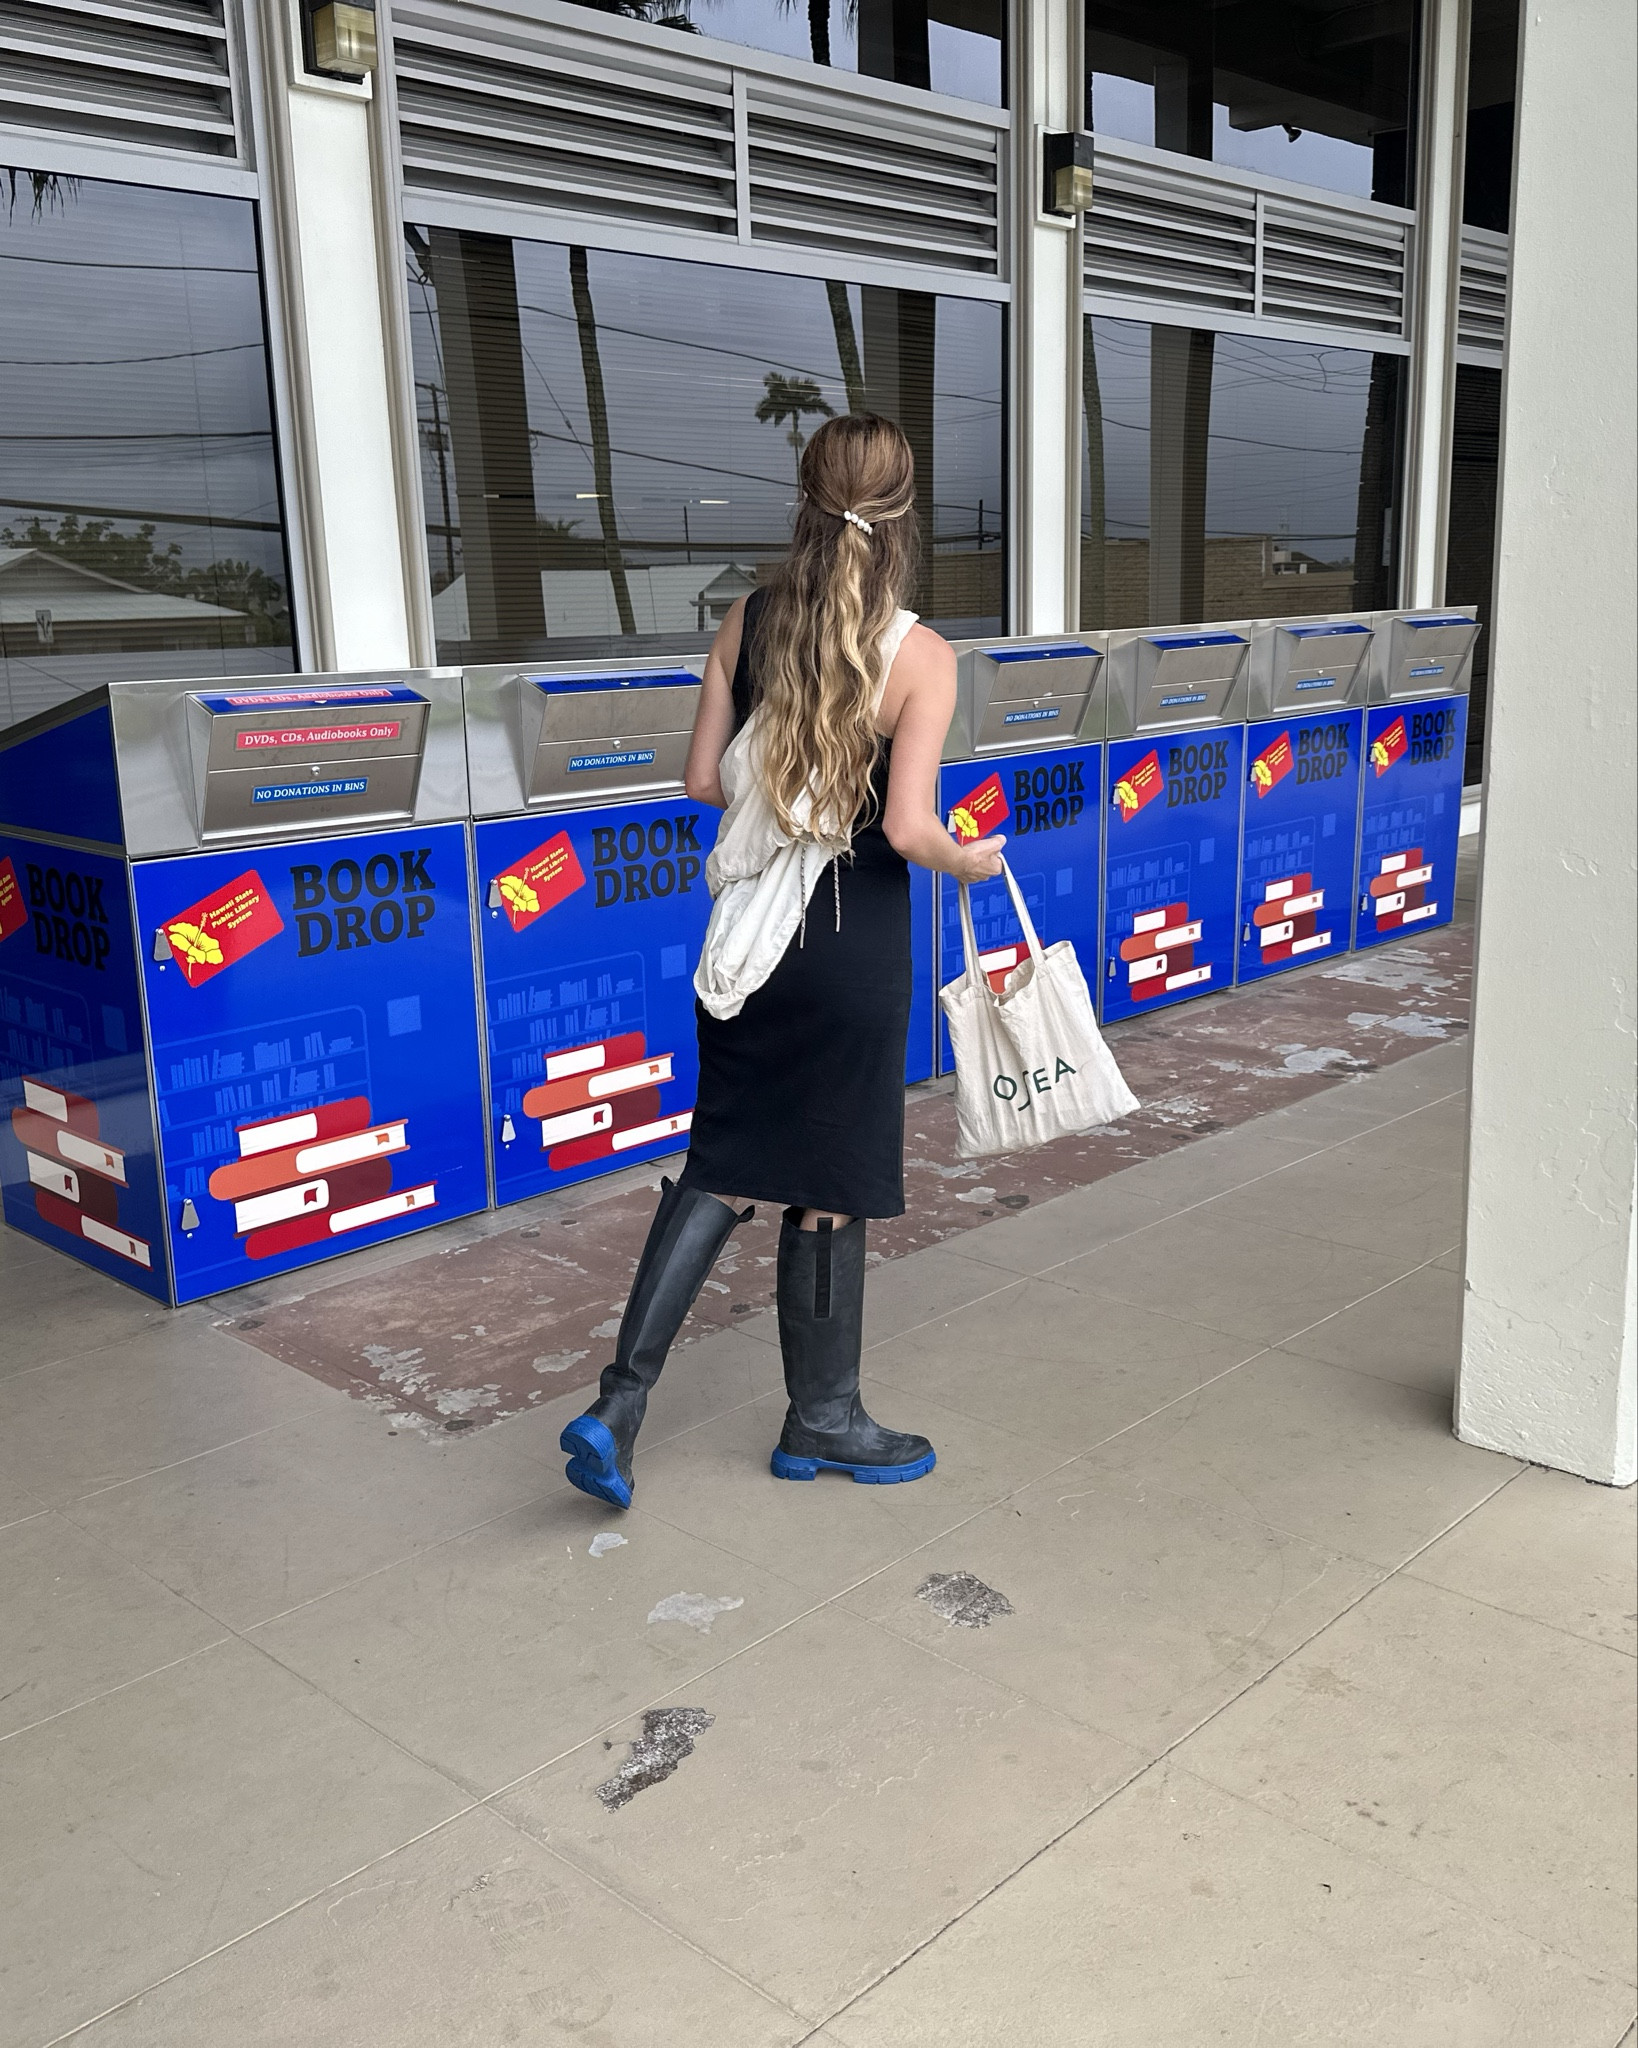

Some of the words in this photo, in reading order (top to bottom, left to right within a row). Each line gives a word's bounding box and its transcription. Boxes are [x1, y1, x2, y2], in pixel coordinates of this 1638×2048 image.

[244, 734, 278, 746] DVDs,
[281, 732, 305, 743] CDs,
[307, 727, 367, 742] Audiobooks
[370, 726, 394, 738] Only
[1297, 723, 1350, 757] BOOK
[1411, 709, 1457, 739] BOOK
[571, 759, 583, 768] NO
[584, 755, 627, 766] DONATIONS
[628, 754, 637, 762] IN
[637, 752, 653, 761] BINS
[1167, 740, 1229, 777] BOOK
[1296, 751, 1348, 785] DROP
[1410, 735, 1455, 766] DROP
[256, 789, 272, 799] NO
[273, 785, 330, 798] DONATIONS
[332, 783, 342, 792] IN
[344, 781, 365, 791] BINS
[1014, 761, 1085, 802] BOOK
[1167, 771, 1228, 808] DROP
[1014, 795, 1084, 836] DROP
[591, 814, 702, 867] BOOK
[25, 863, 109, 925] BOOK
[290, 848, 436, 911] BOOK
[593, 856, 701, 909] DROP
[209, 899, 235, 919] Hawaii
[234, 888, 254, 903] State
[211, 911, 235, 929] Public
[234, 894, 260, 914] Library
[227, 910, 253, 929] System
[31, 910, 111, 971] DROP
[295, 895, 436, 958] DROP
[993, 1056, 1077, 1112] OSEA
